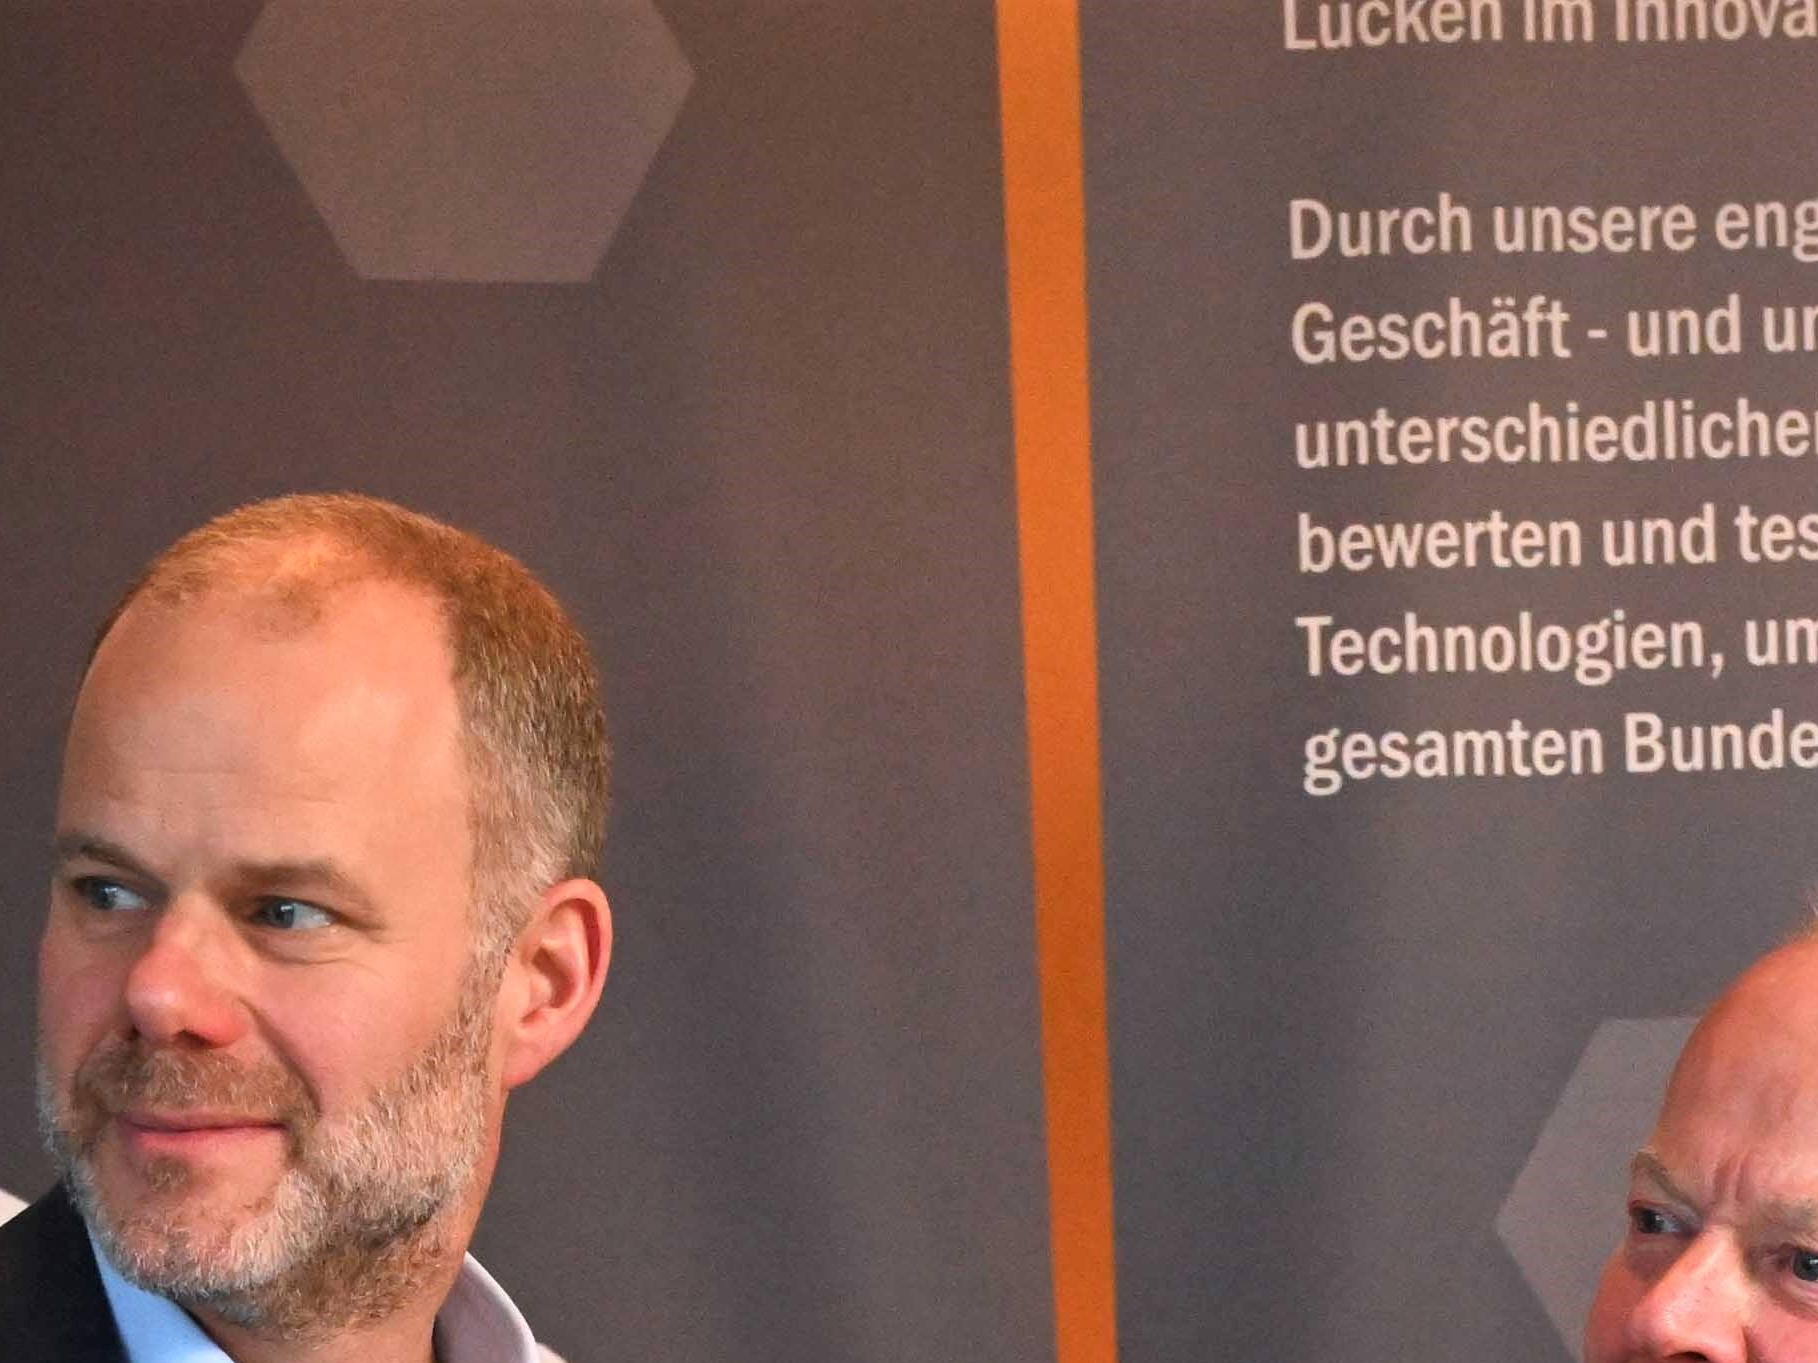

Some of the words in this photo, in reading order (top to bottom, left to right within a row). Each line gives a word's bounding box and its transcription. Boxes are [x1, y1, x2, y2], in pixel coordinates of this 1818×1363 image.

[1289, 191, 1473, 260] Durch
[1493, 203, 1697, 254] unsere
[1291, 294, 1572, 365] Geschäft
[1627, 292, 1741, 358] und
[1298, 509, 1582, 573] bewerten
[1602, 502, 1716, 567] und
[1294, 608, 1724, 686] Technologien,
[1303, 718, 1604, 796] gesamten
